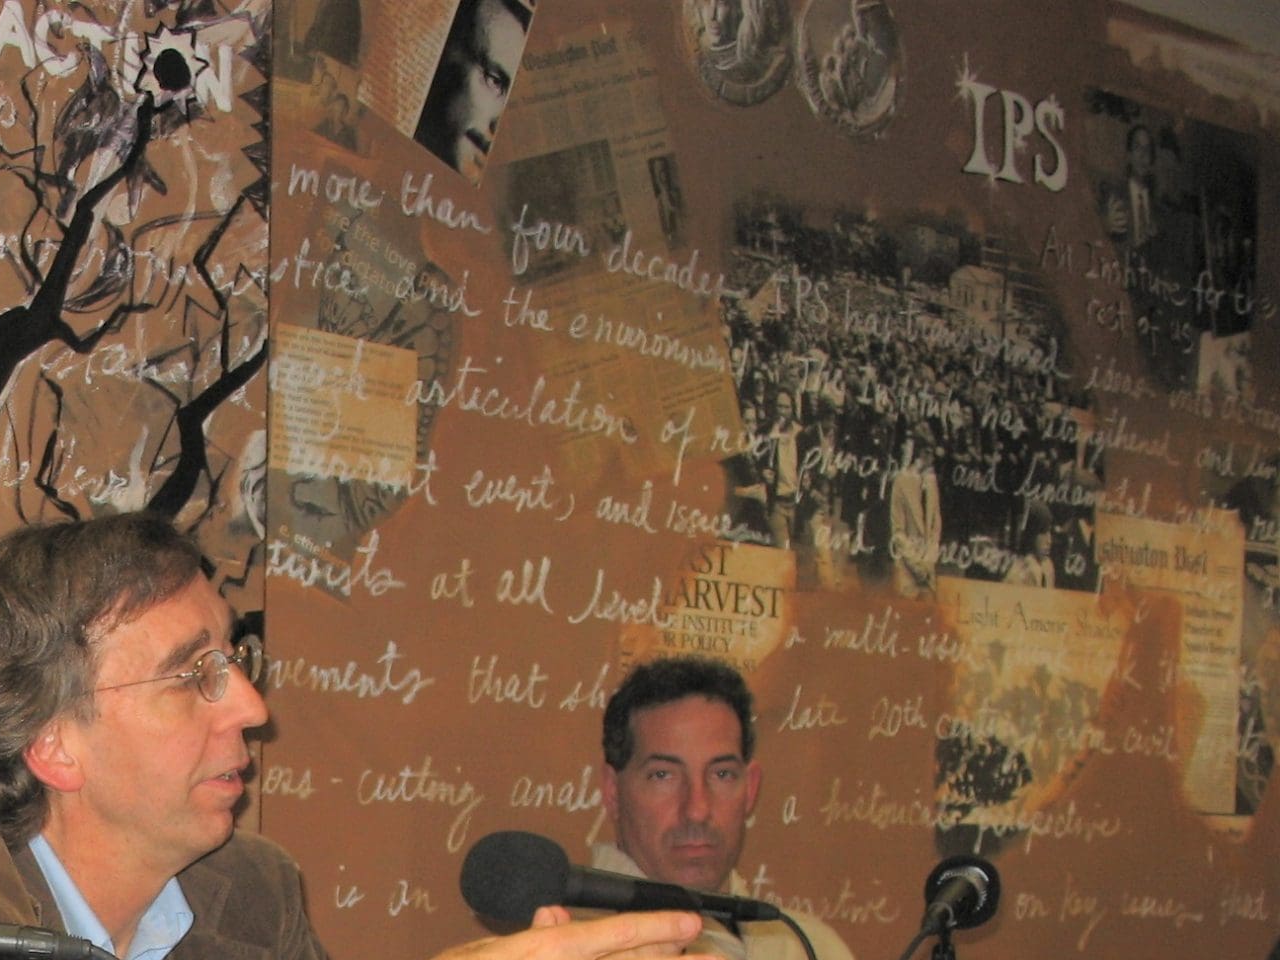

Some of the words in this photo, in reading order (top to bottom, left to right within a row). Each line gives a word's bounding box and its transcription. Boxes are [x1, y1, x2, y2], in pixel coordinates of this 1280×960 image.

[959, 80, 1069, 192] IPS
[287, 162, 382, 209] more
[399, 169, 492, 236] than
[511, 203, 591, 276] four
[502, 284, 555, 333] the
[660, 406, 697, 487] of
[595, 482, 658, 536] and
[430, 558, 476, 609] at
[495, 556, 555, 615] all
[467, 654, 550, 710] that
[868, 694, 929, 742] 20th
[333, 863, 366, 909] is
